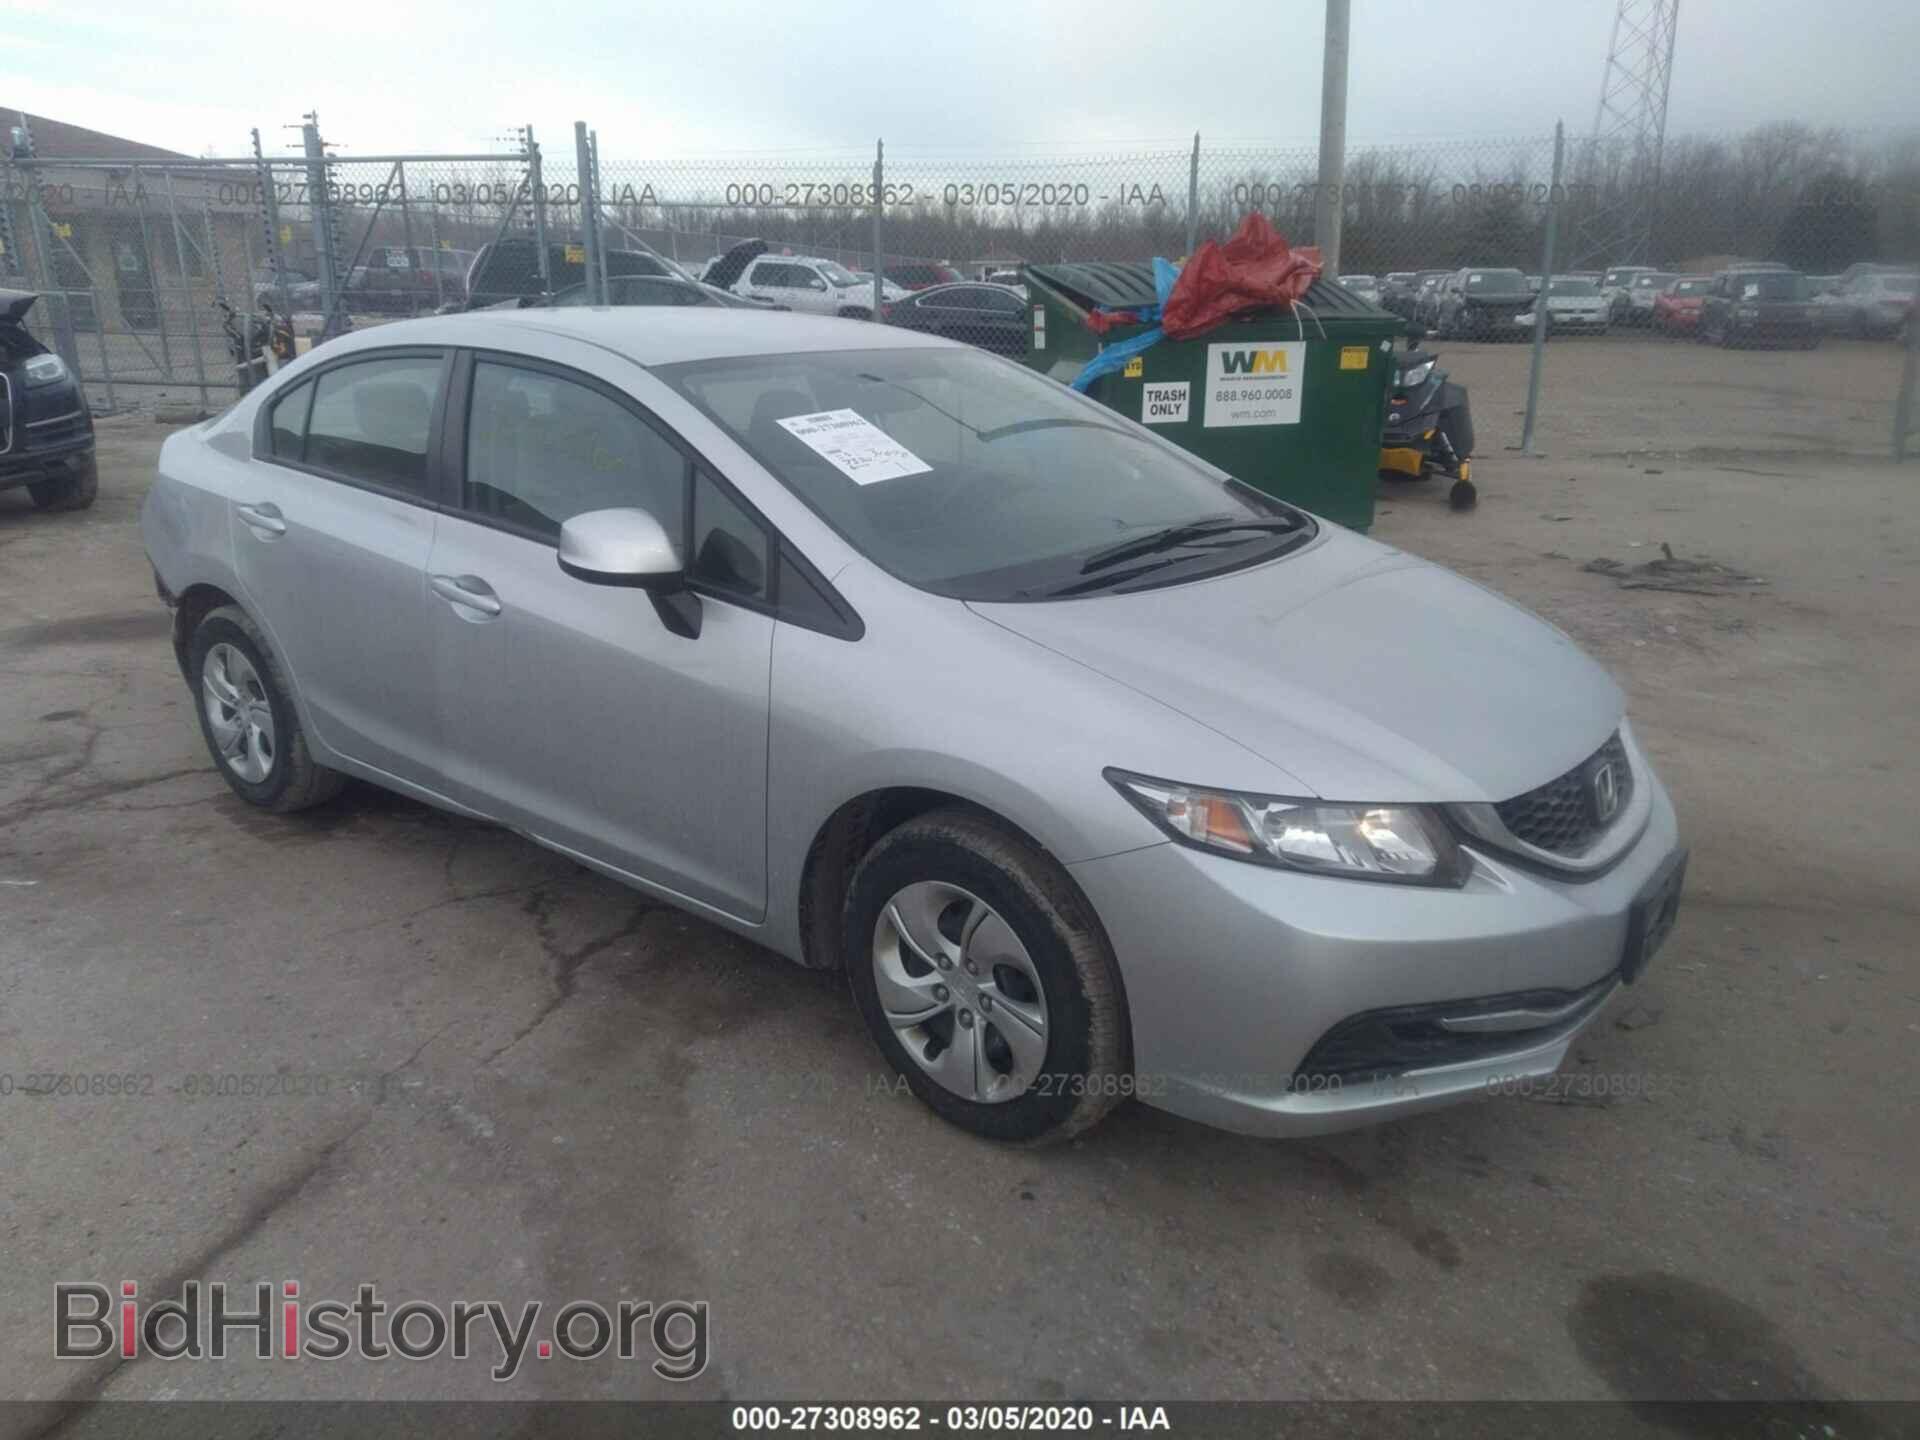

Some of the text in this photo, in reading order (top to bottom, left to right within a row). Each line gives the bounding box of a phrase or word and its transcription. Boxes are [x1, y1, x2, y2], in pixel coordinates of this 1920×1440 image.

[1221, 350, 1288, 374] WM
[1146, 389, 1187, 402] TRASH
[1215, 388, 1294, 402] 888.960.0008
[1150, 402, 1183, 416] ONLY
[1230, 409, 1277, 419] wm.com
